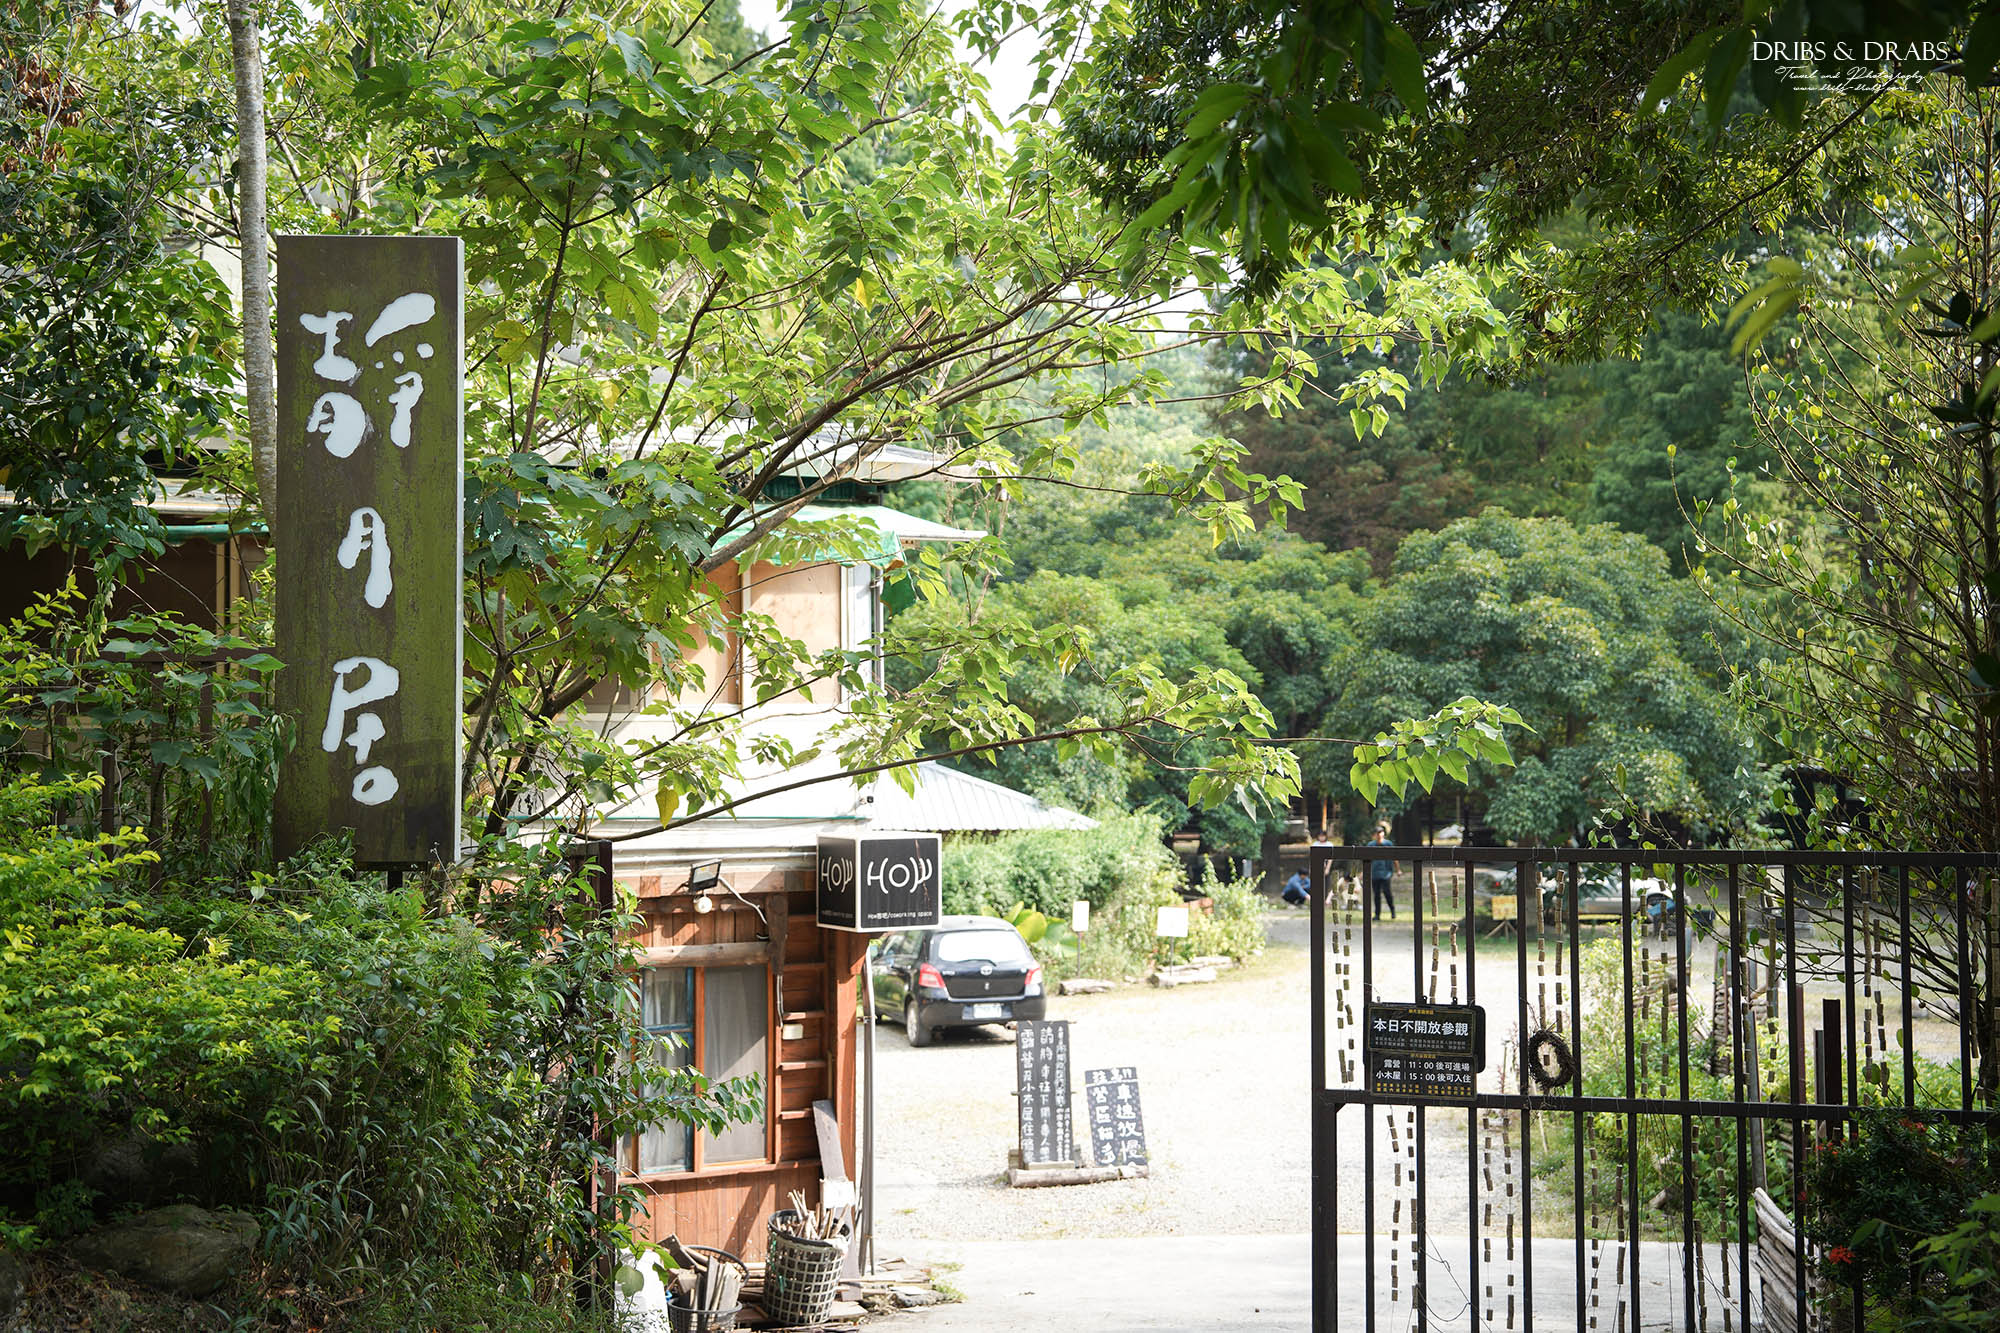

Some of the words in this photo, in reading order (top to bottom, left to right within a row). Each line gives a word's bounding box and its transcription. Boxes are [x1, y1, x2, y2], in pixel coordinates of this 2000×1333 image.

[1373, 1018, 1469, 1036] 本日不開放參觀
[1376, 1070, 1401, 1080] 小木屋
[1437, 1073, 1471, 1083] 後可入住
